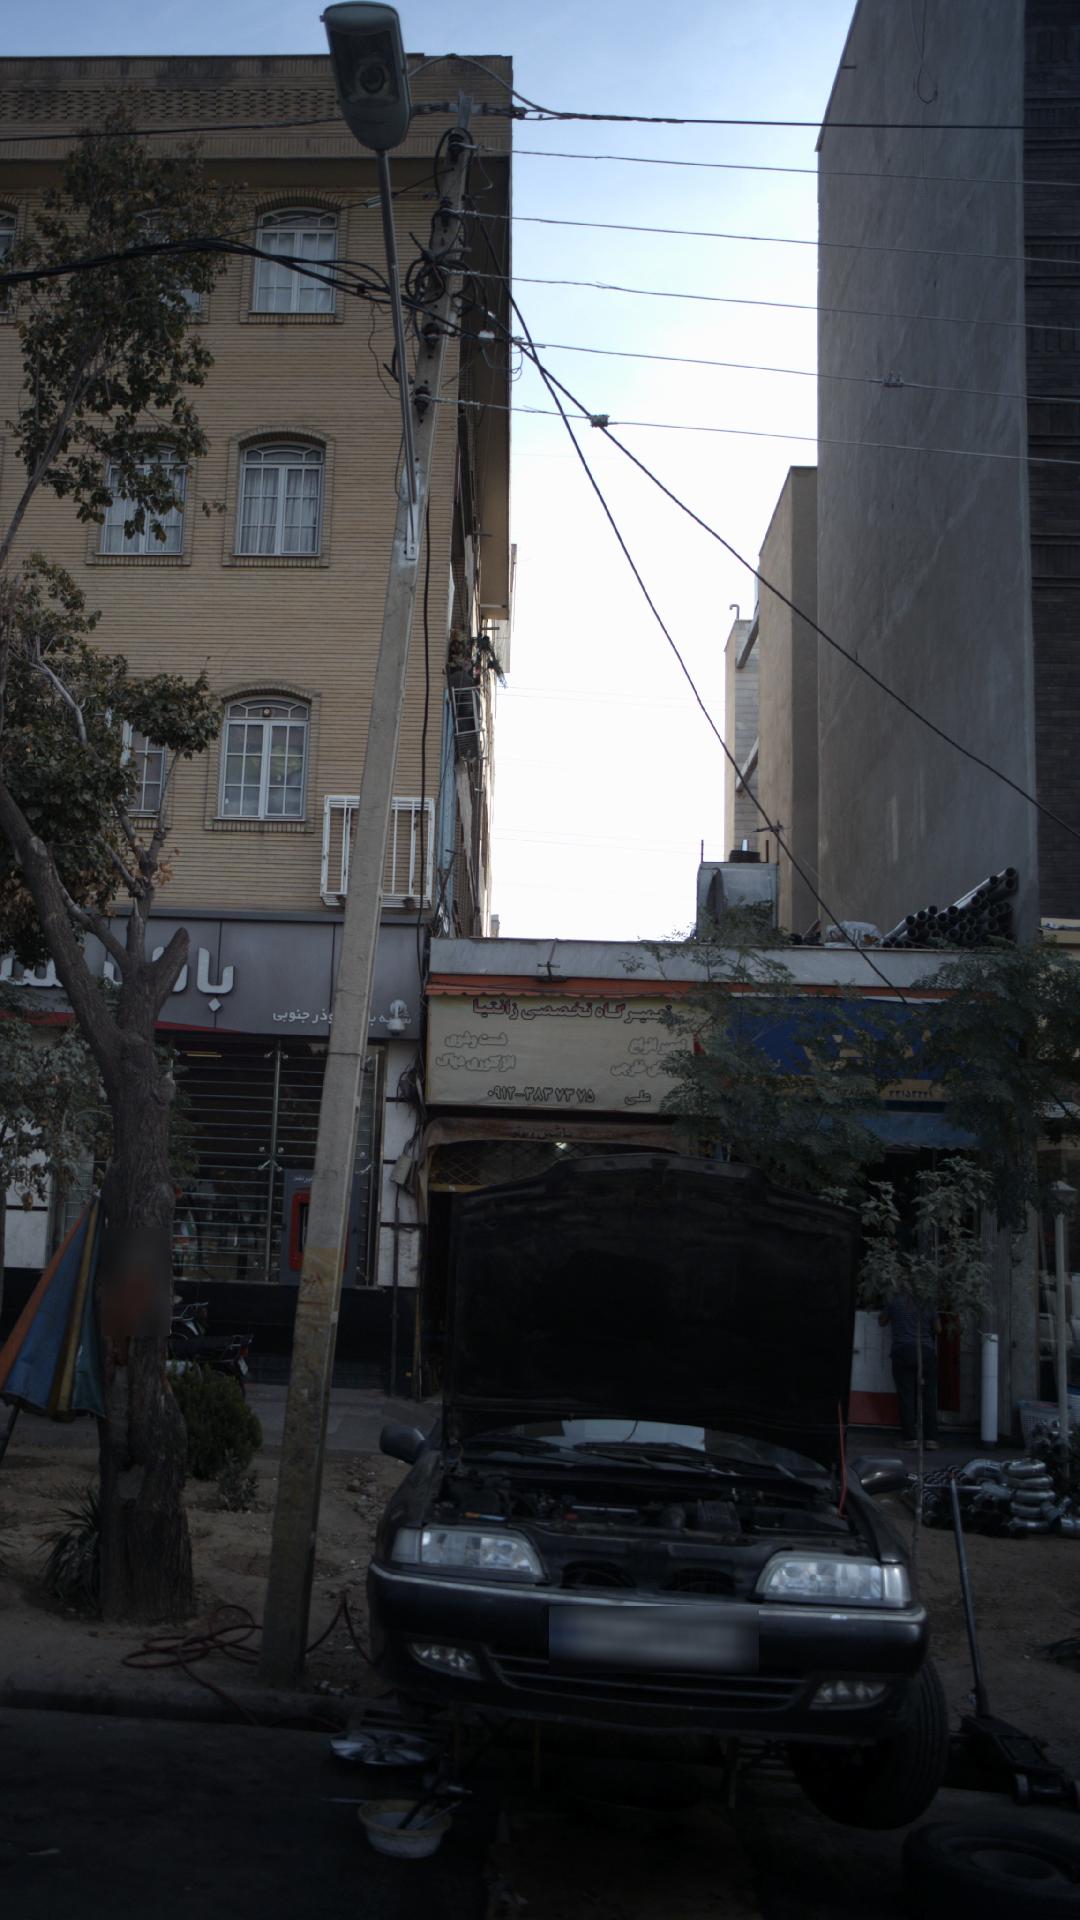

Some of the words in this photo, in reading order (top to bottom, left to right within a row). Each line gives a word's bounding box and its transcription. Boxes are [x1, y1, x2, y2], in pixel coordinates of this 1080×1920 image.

[272, 1008, 310, 1024] جنوبی
[472, 998, 519, 1020] زانتیا
[521, 1001, 593, 1020] تخصصی
[624, 1089, 652, 1106] علی
